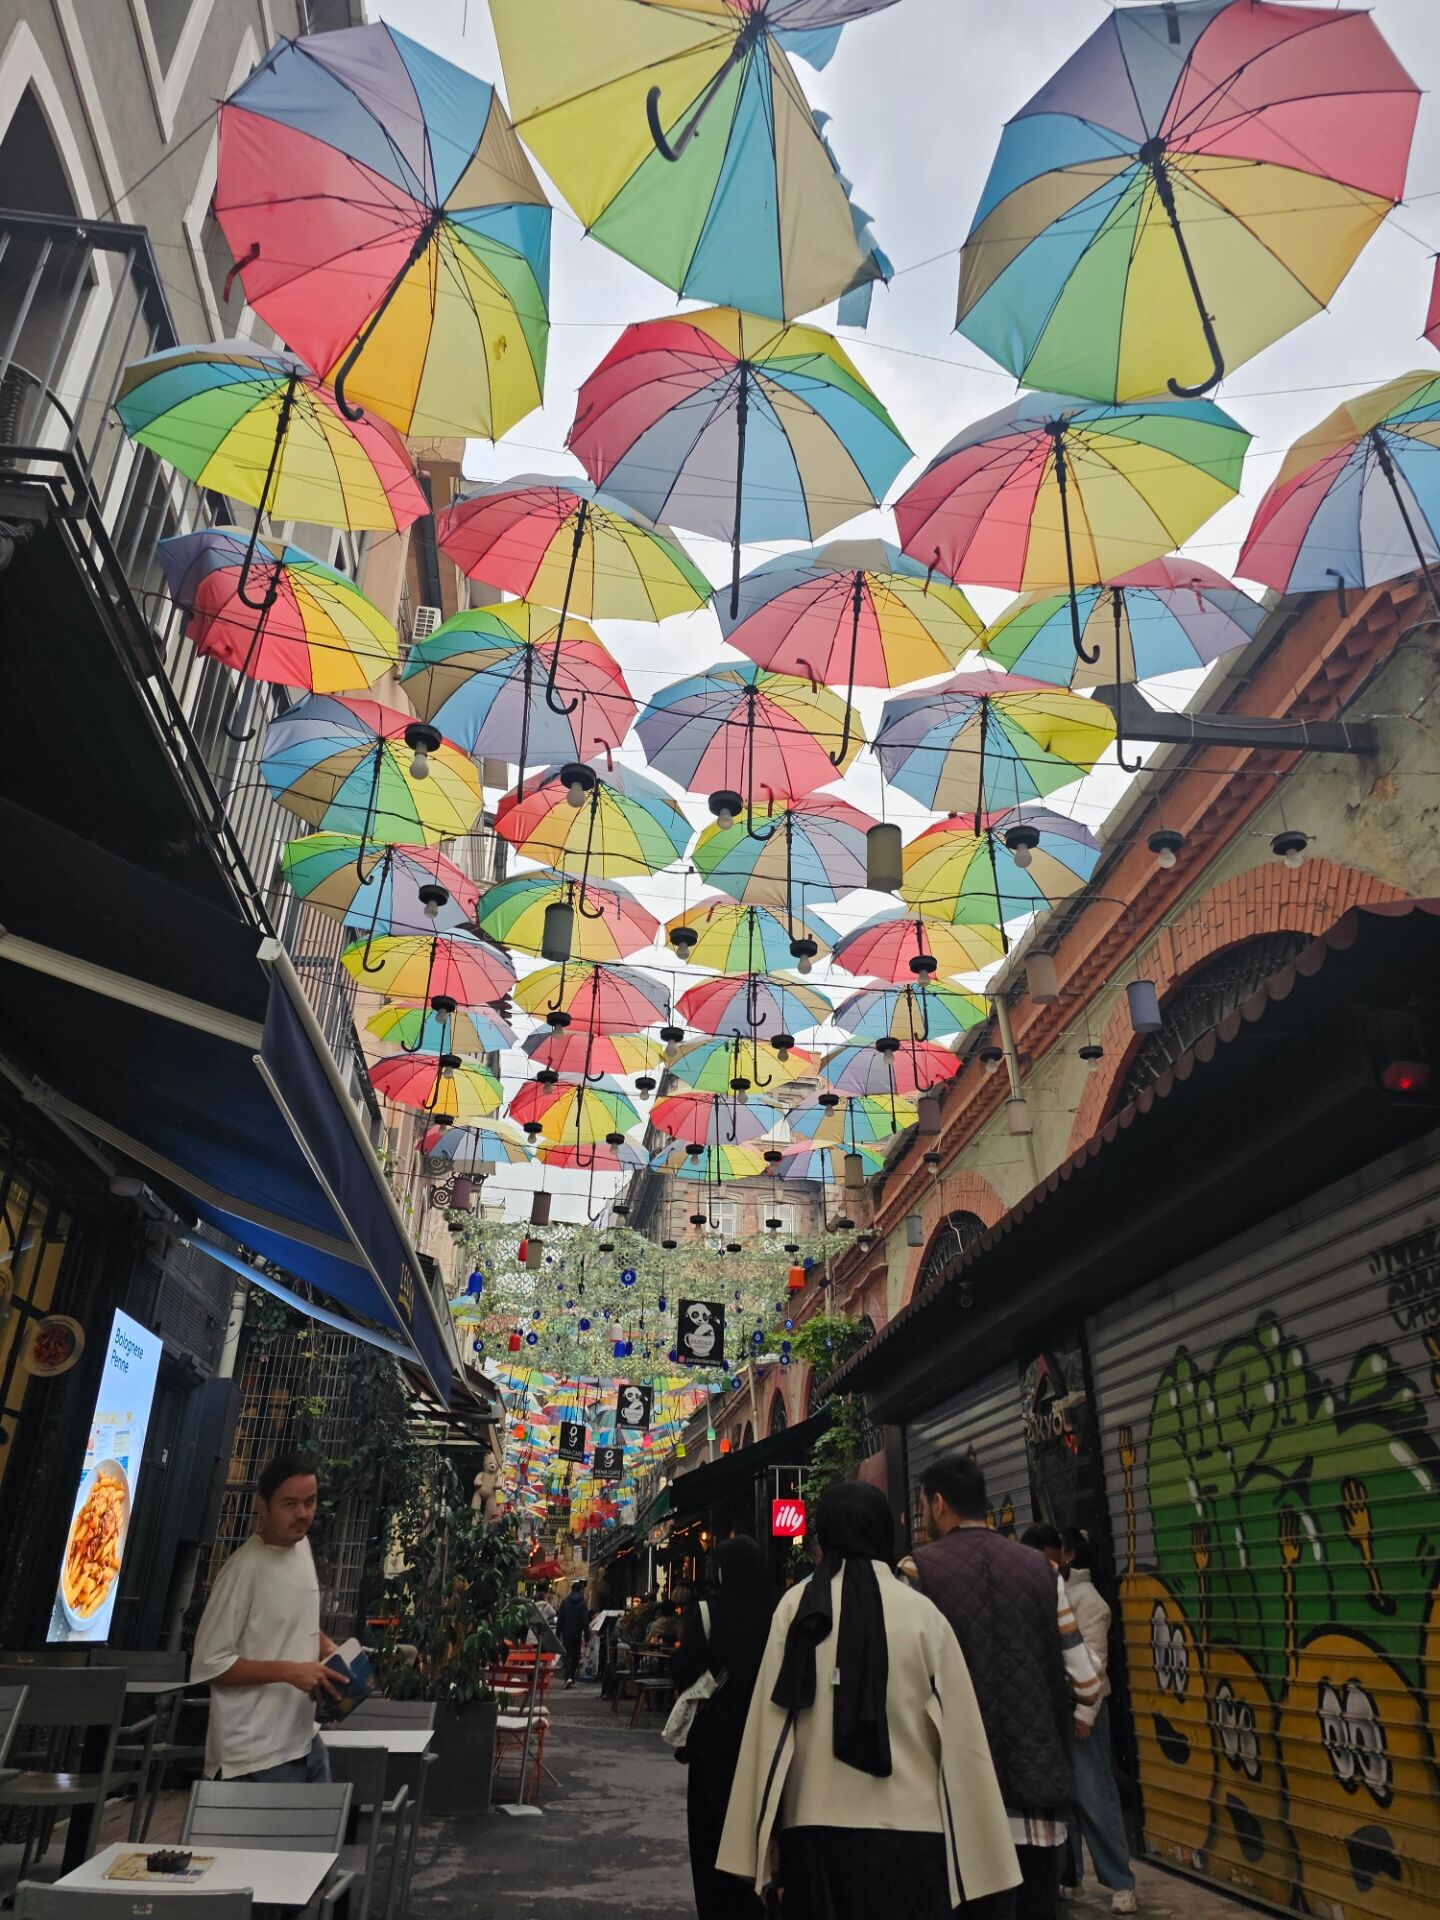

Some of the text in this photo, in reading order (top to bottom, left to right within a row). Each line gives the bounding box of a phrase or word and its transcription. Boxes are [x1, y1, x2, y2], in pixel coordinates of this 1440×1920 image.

[114, 1327, 144, 1360] Bolognese
[110, 1349, 129, 1374] Penne
[775, 1505, 804, 1533] illy
